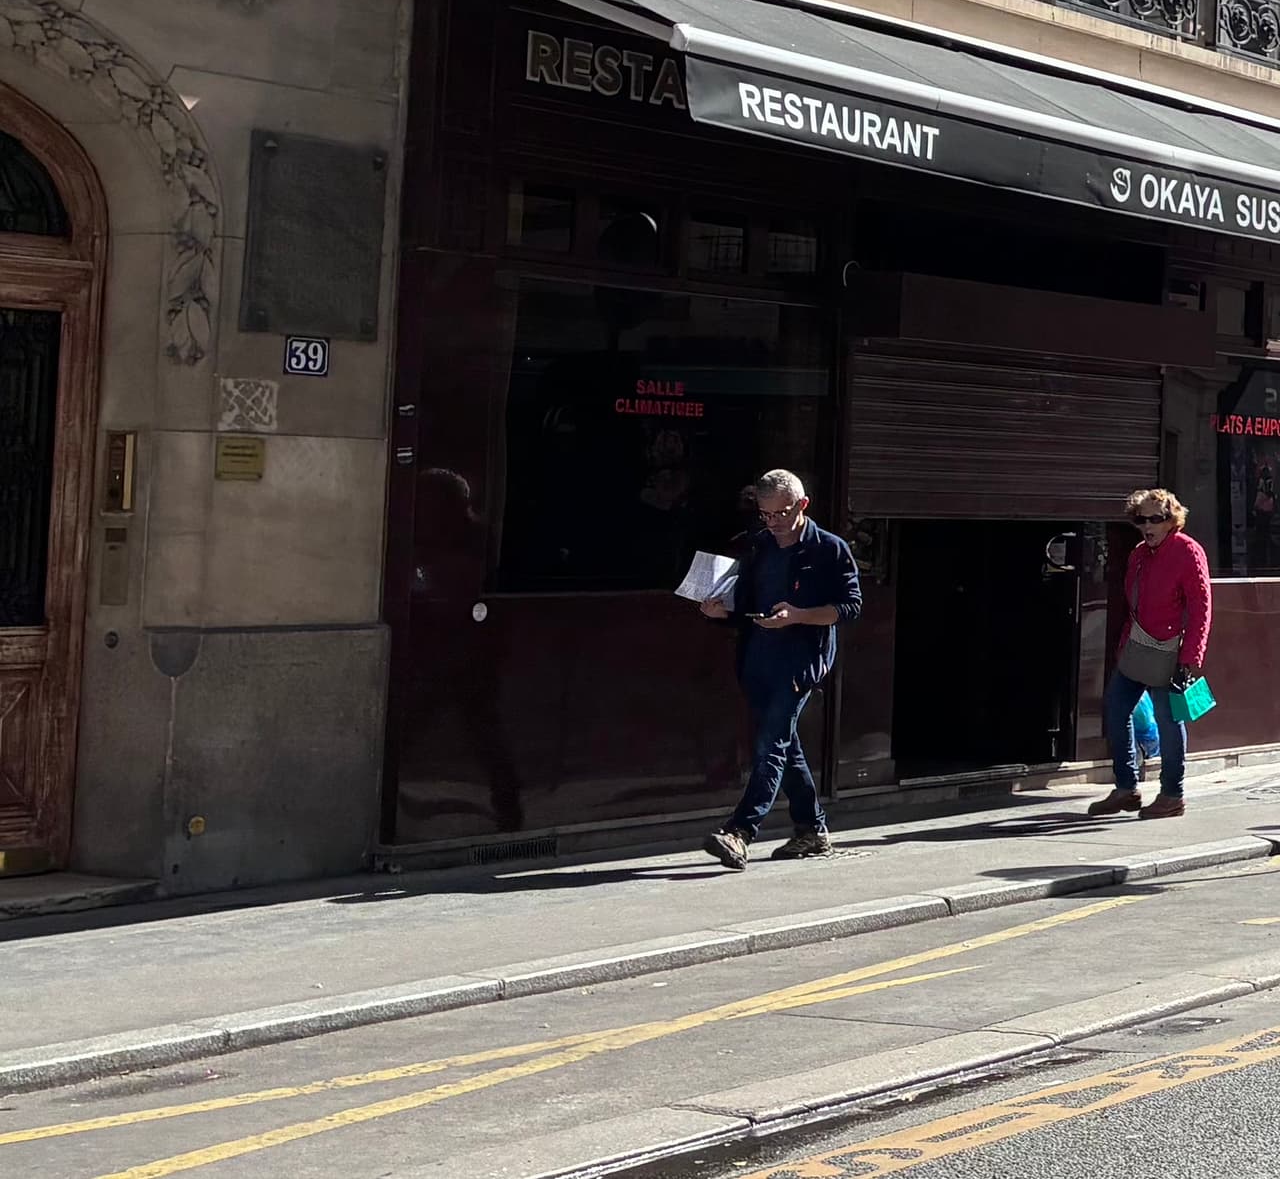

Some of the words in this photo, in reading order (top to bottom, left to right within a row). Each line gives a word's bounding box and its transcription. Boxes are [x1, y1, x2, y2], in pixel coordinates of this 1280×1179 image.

[737, 81, 940, 162] RESTAURANT
[1139, 172, 1225, 223] OKAYA
[290, 341, 324, 372] 39
[635, 379, 686, 397] SALLE
[1244, 417, 1253, 435] A
